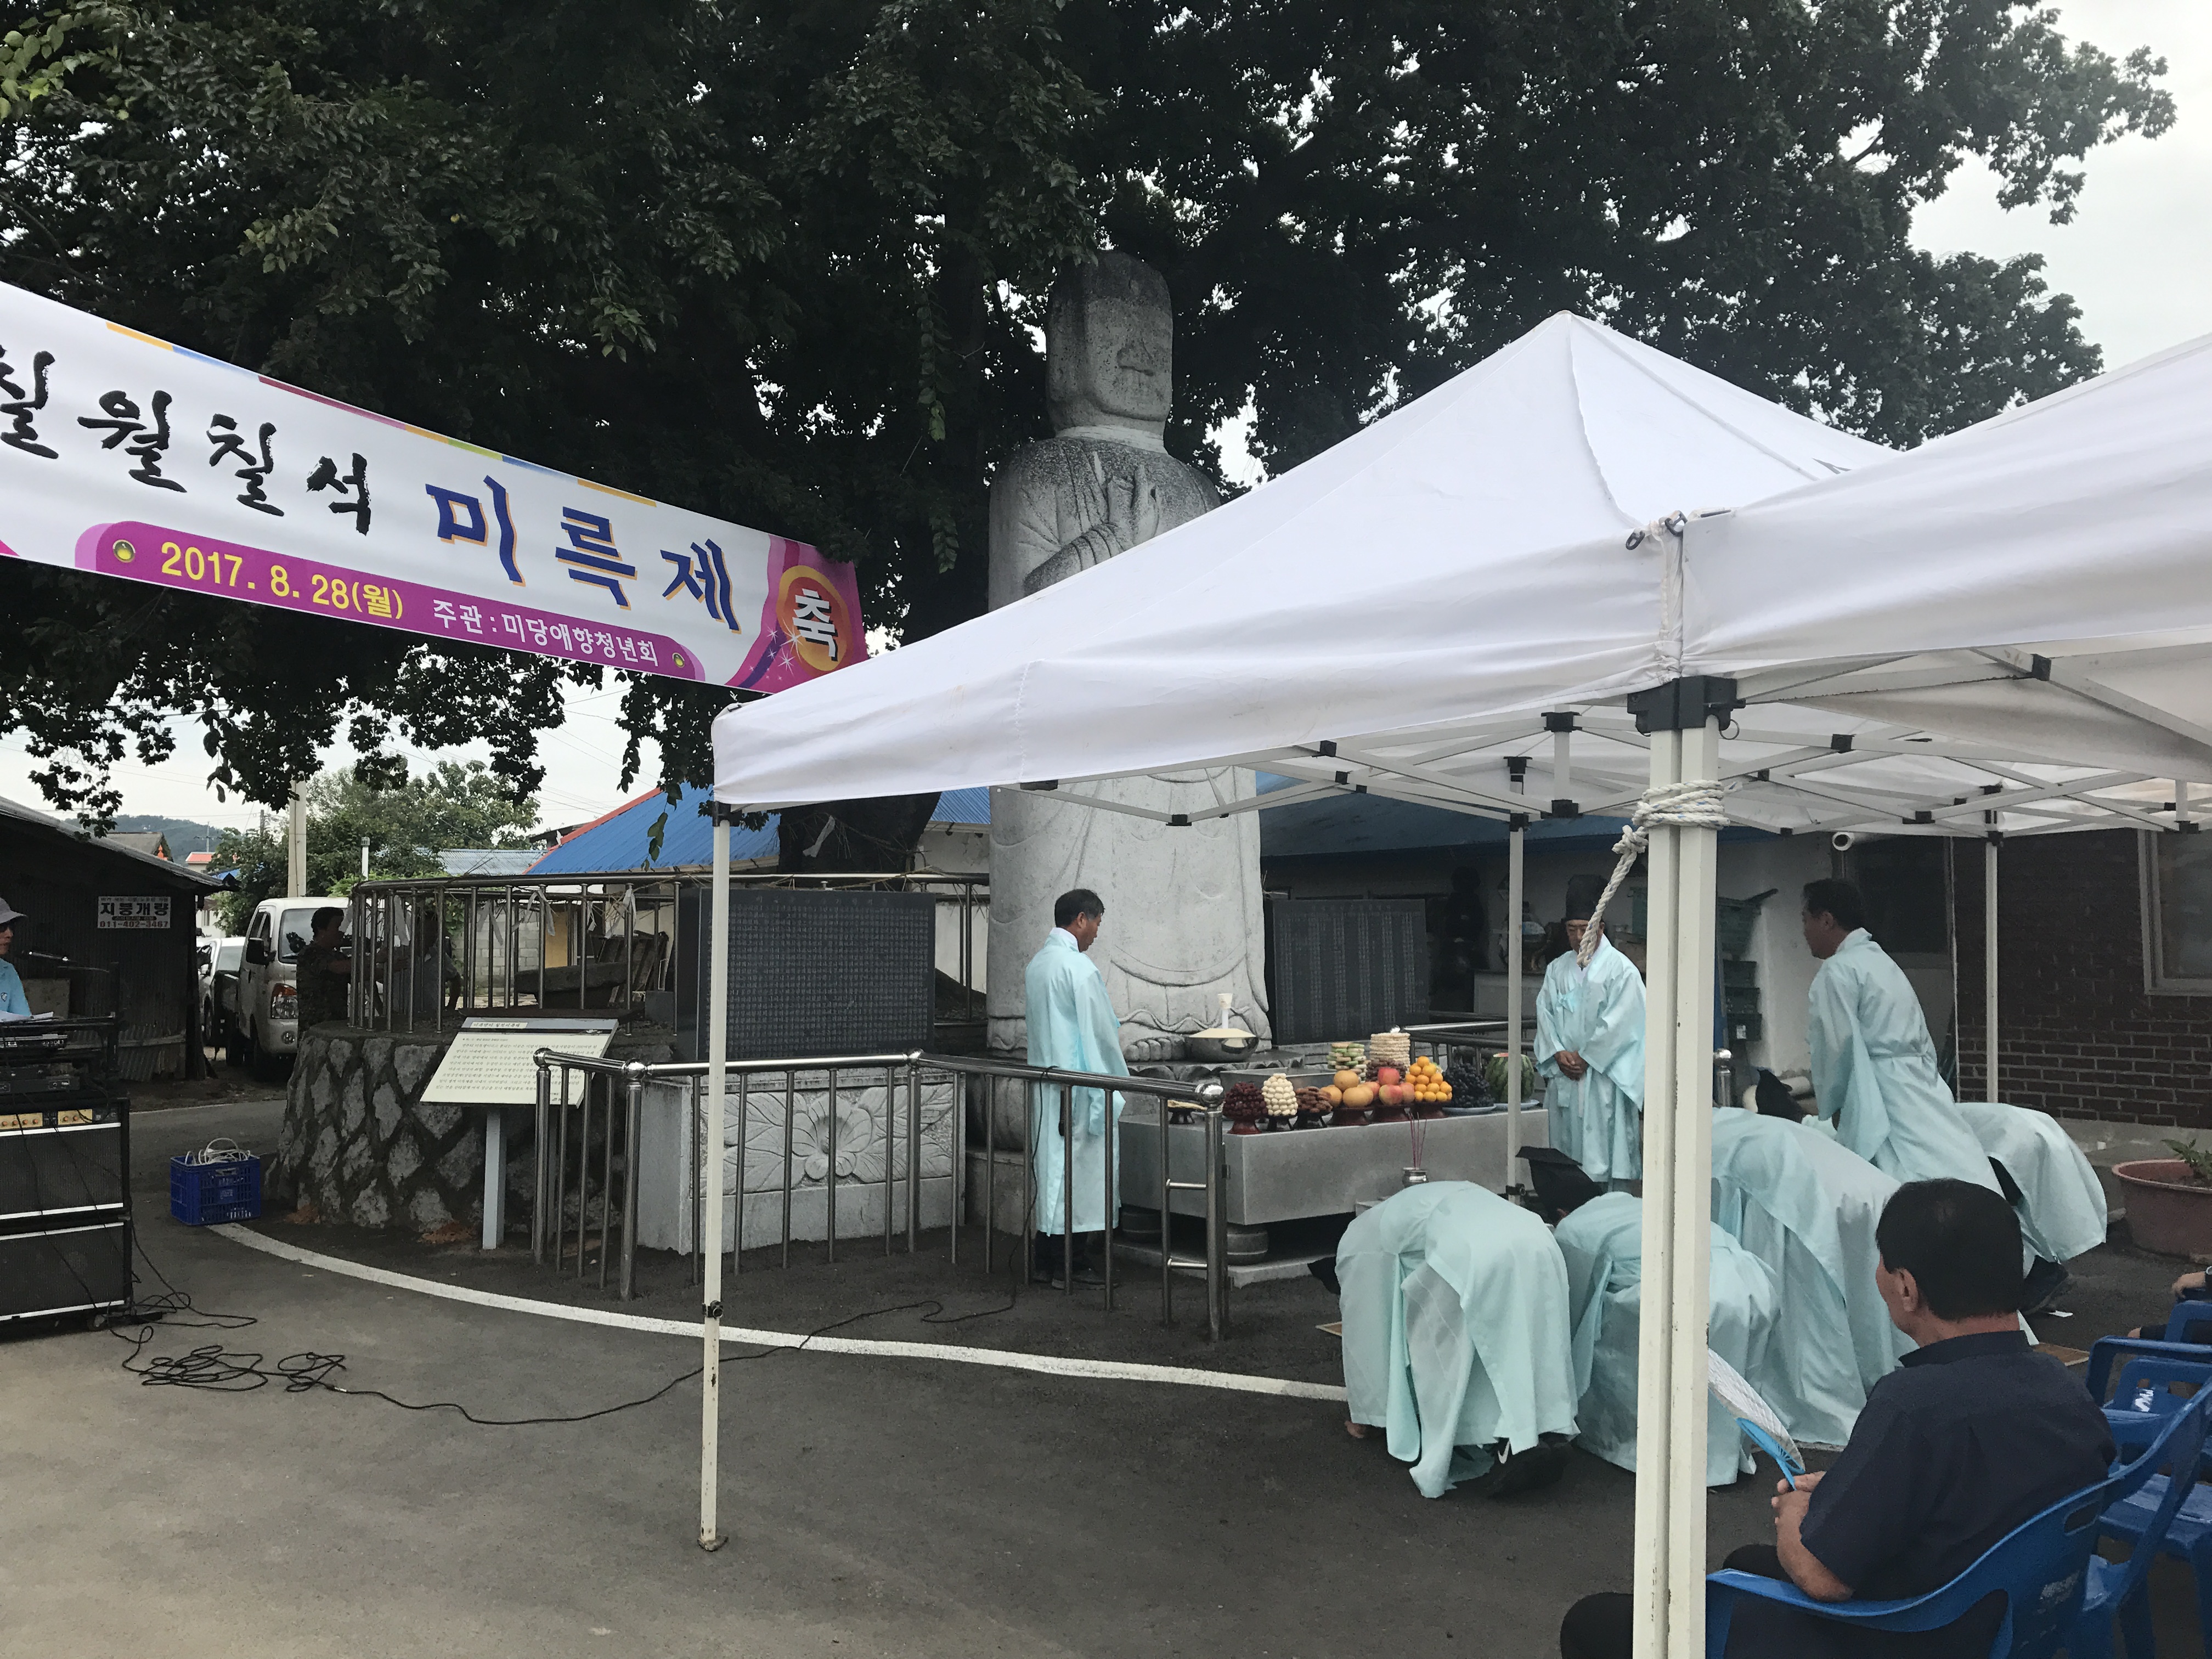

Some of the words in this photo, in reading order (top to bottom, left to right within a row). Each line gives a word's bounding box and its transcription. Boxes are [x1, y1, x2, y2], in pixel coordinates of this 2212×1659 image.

[161, 541, 256, 589] 2017.
[270, 565, 300, 598] 8.
[311, 574, 403, 619] 28(월)
[501, 613, 658, 667] 미당애향청년회
[792, 588, 838, 661] 축
